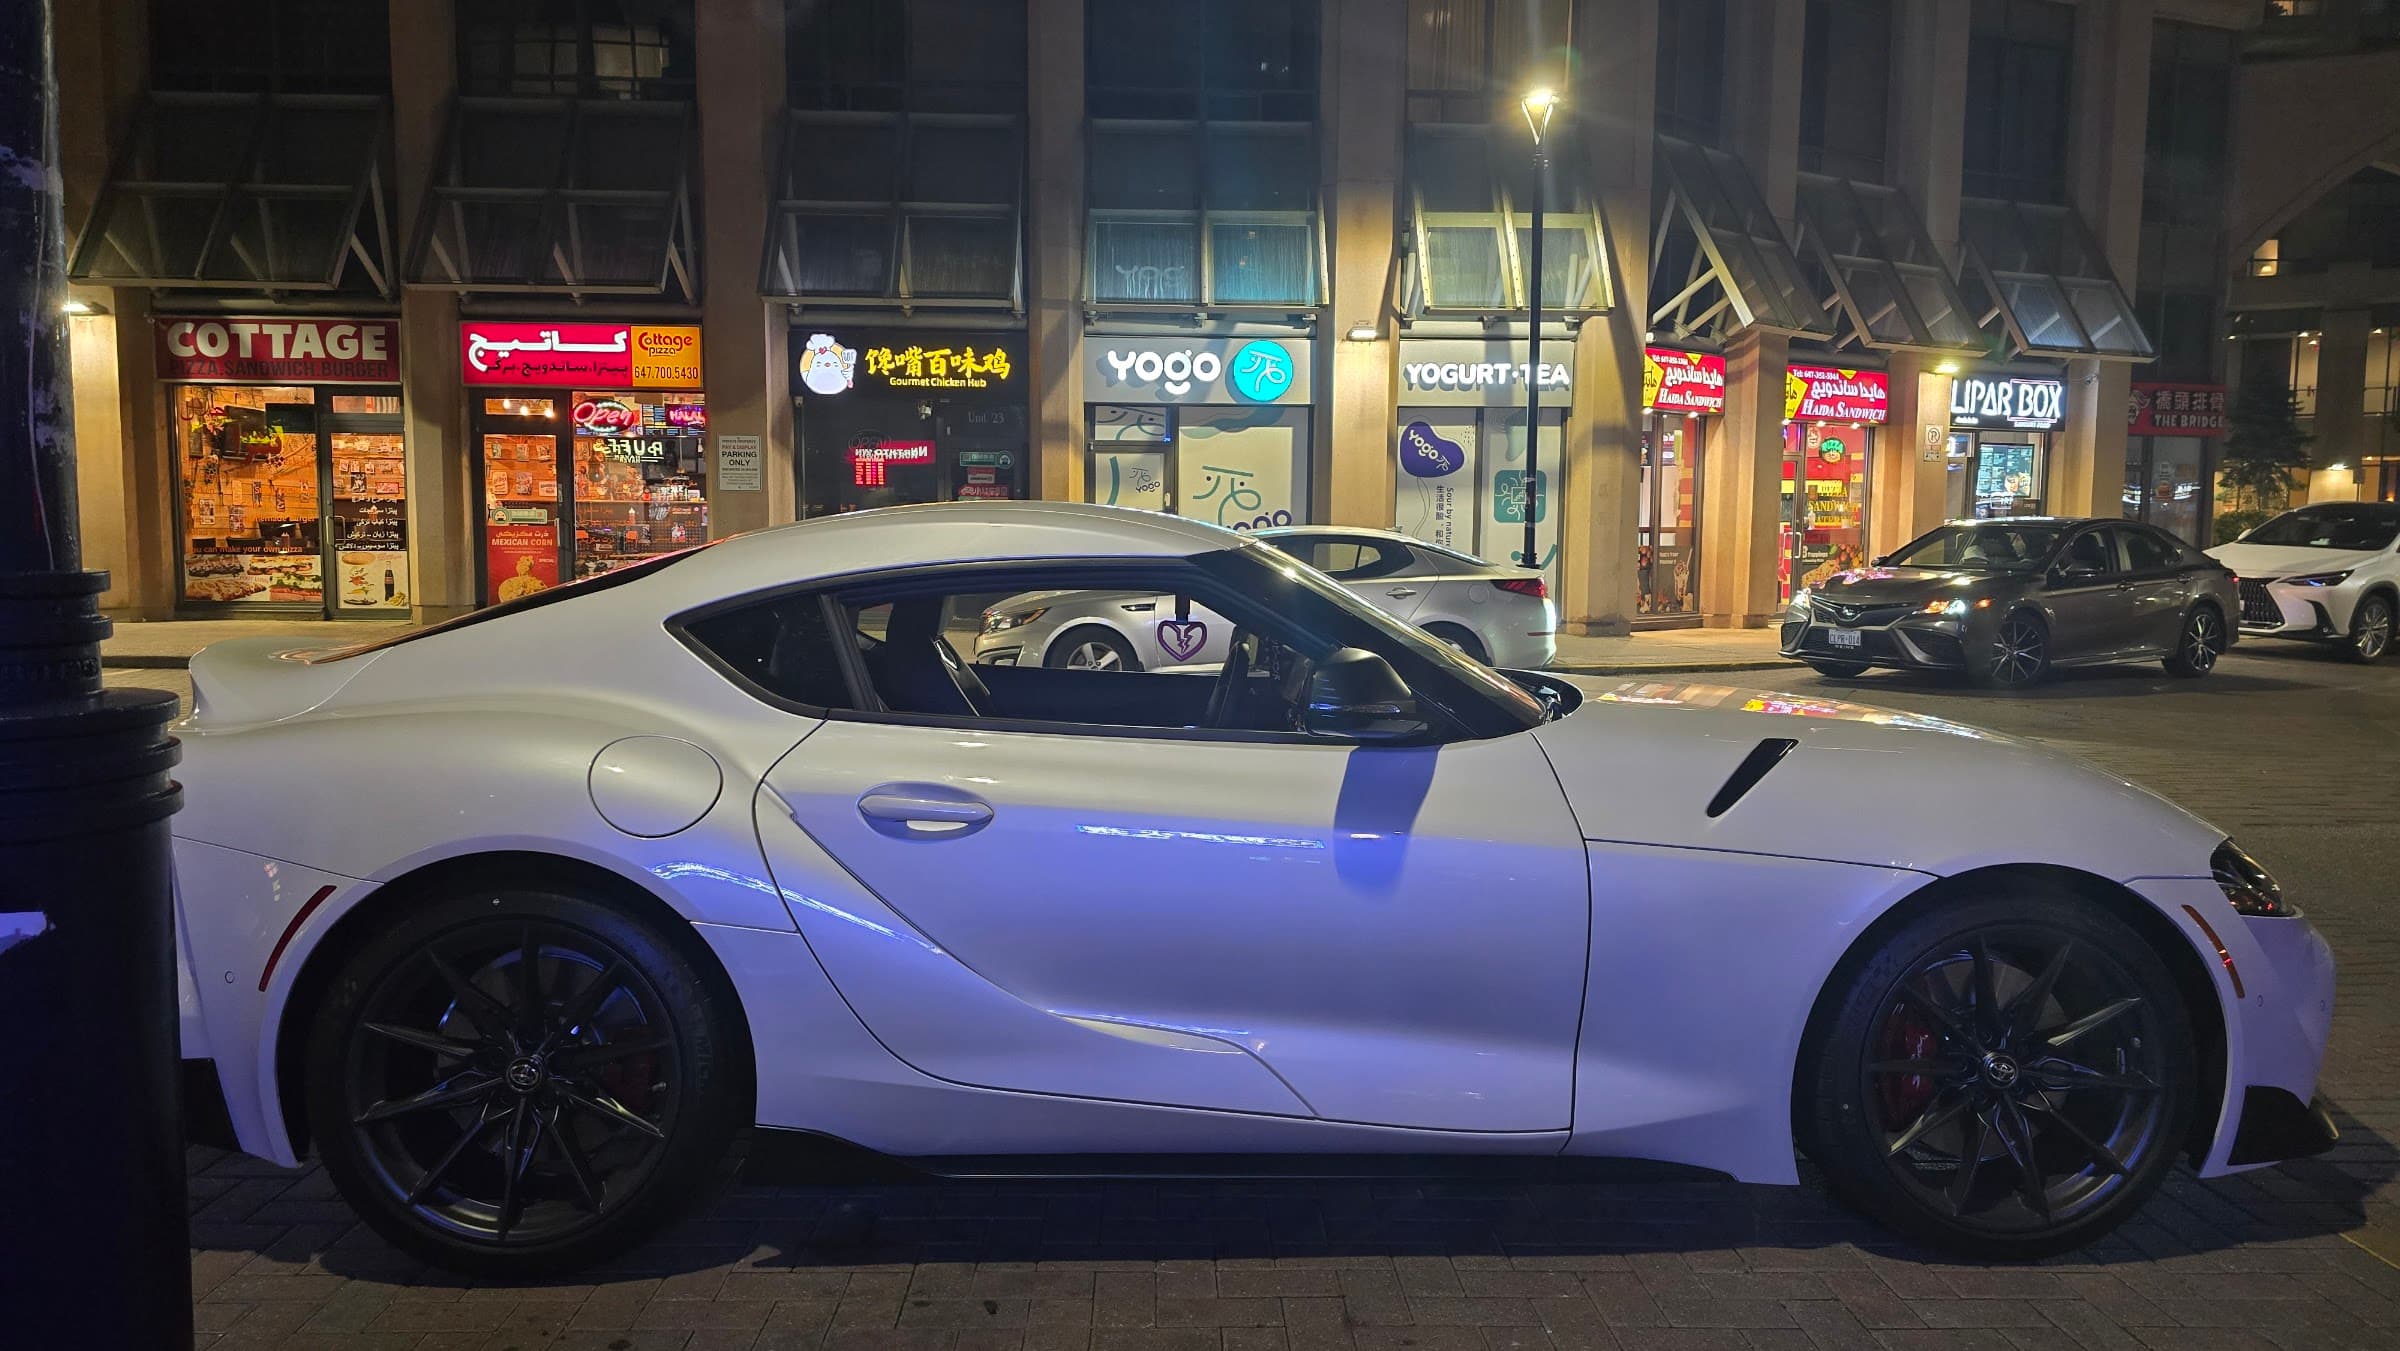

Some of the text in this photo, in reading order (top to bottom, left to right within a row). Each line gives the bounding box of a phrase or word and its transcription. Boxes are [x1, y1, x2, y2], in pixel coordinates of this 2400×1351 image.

[167, 322, 388, 361] COTTAGE
[638, 331, 693, 351] Cottage
[648, 346, 676, 357] pizza
[865, 345, 1011, 380] 馋嘴百味鸡
[634, 365, 699, 380] 647.700.5430
[889, 377, 987, 388] Gourmet Chicken Hub
[1658, 388, 1723, 408] HAIDA SANDWICH
[1951, 379, 2063, 419] LIPAR BOX
[573, 401, 632, 426] Open
[670, 409, 706, 426] HALAL
[1800, 398, 1887, 421] HAIDA SANDWICH
[2154, 414, 2177, 427] THE
[1446, 487, 1454, 507] Sour
[1445, 508, 1454, 520] by
[242, 546, 261, 554] your
[281, 546, 303, 554] pizza
[491, 538, 553, 546] MEXICAN CORN
